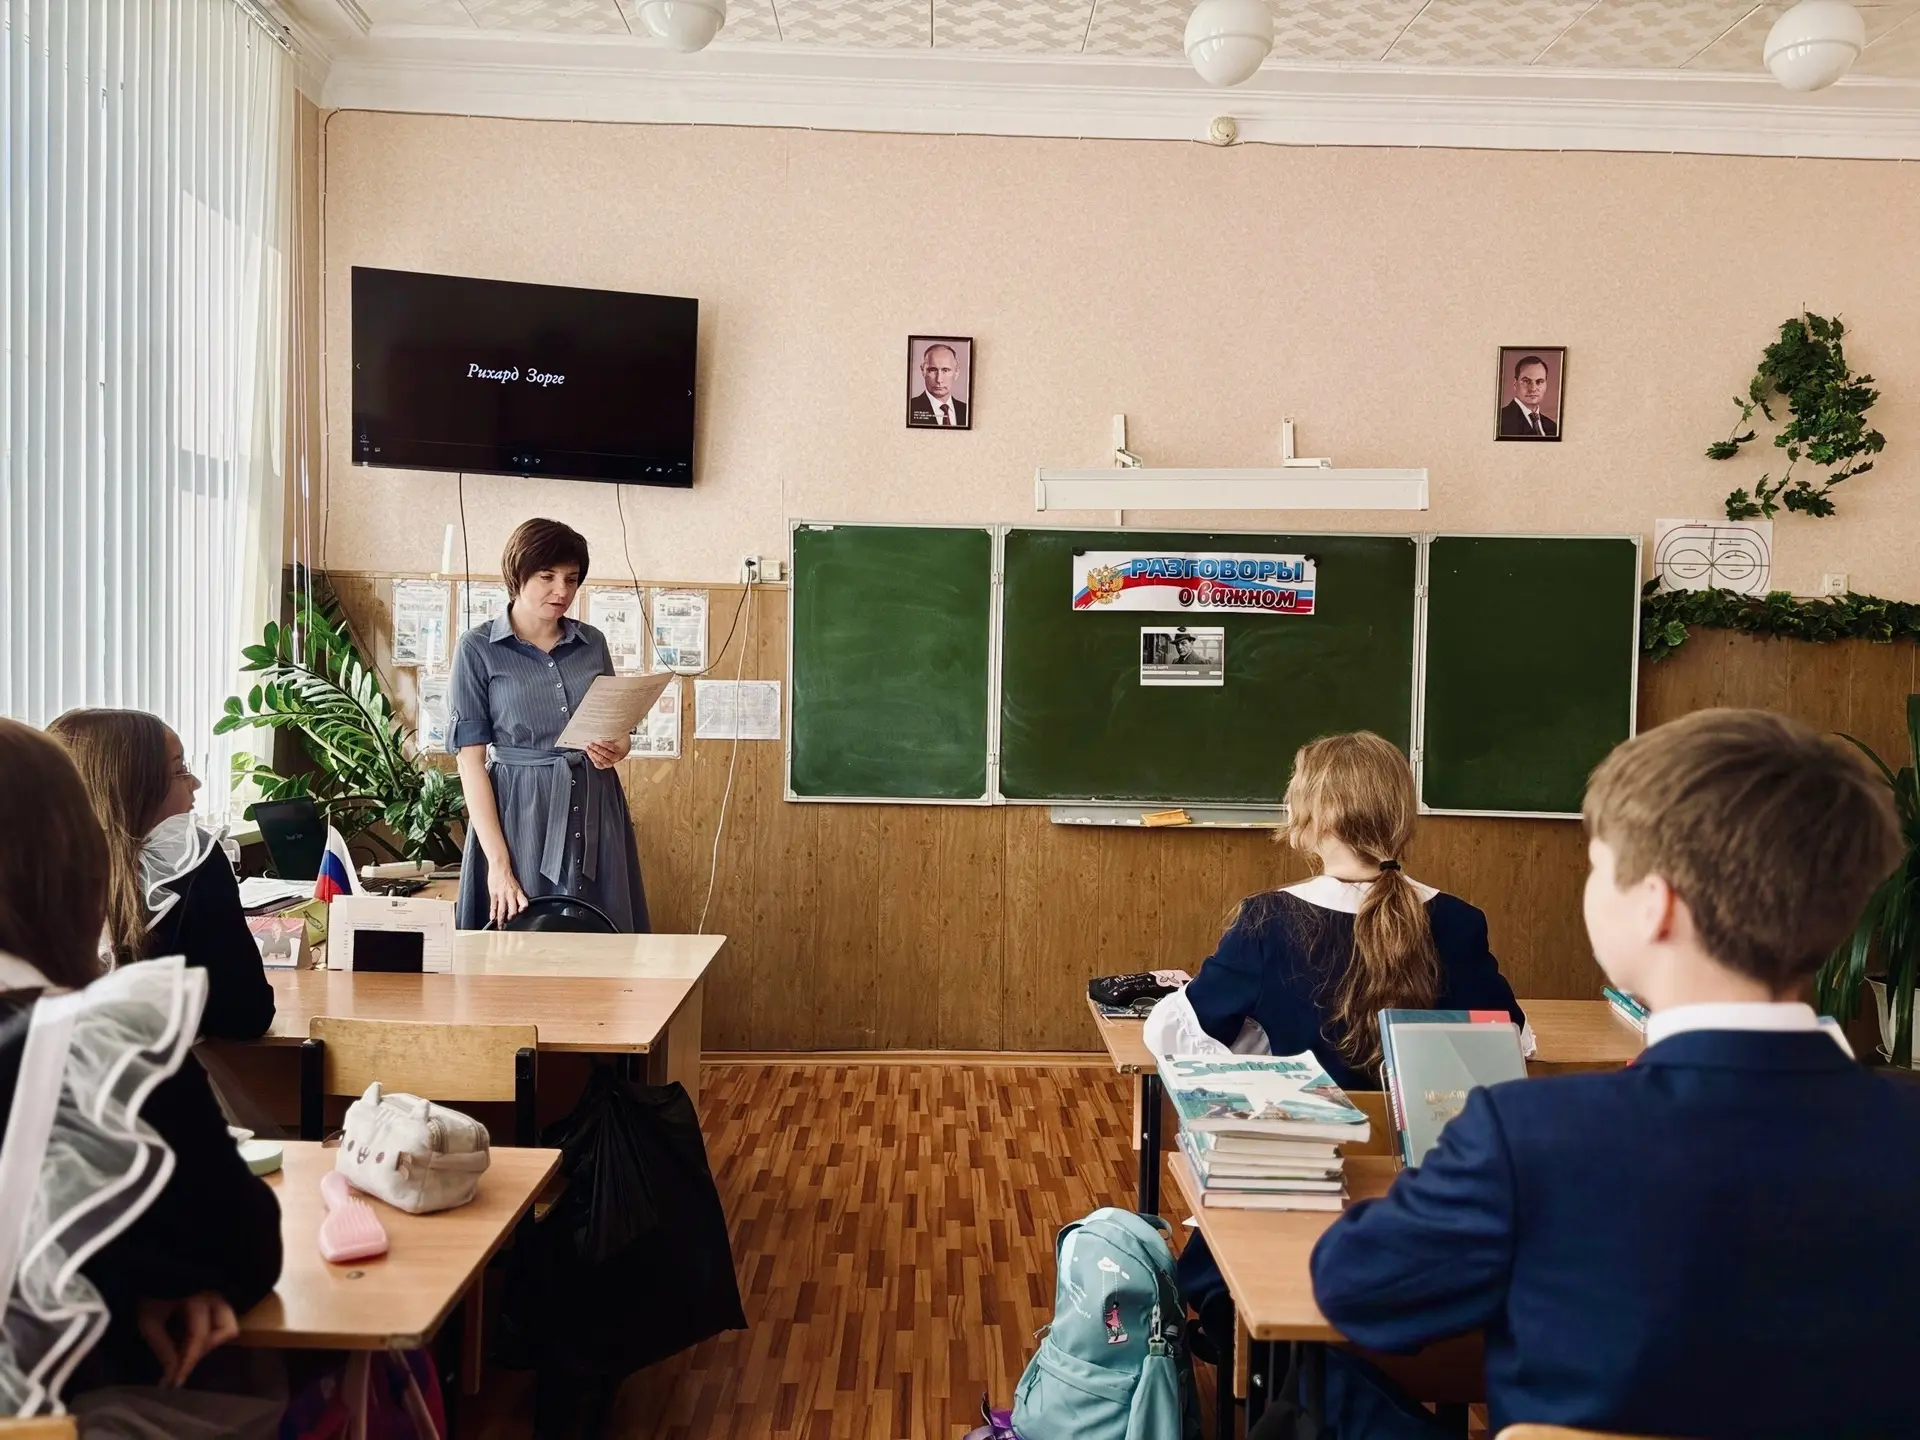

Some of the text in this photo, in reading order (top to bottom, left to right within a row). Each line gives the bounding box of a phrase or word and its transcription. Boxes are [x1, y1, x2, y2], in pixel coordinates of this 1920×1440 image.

[467, 363, 565, 387] Рихард Зорге
[1131, 558, 1303, 581] РАЗГОВОРЫ
[1178, 580, 1298, 608] о важном
[1173, 1060, 1312, 1077] Starlight
